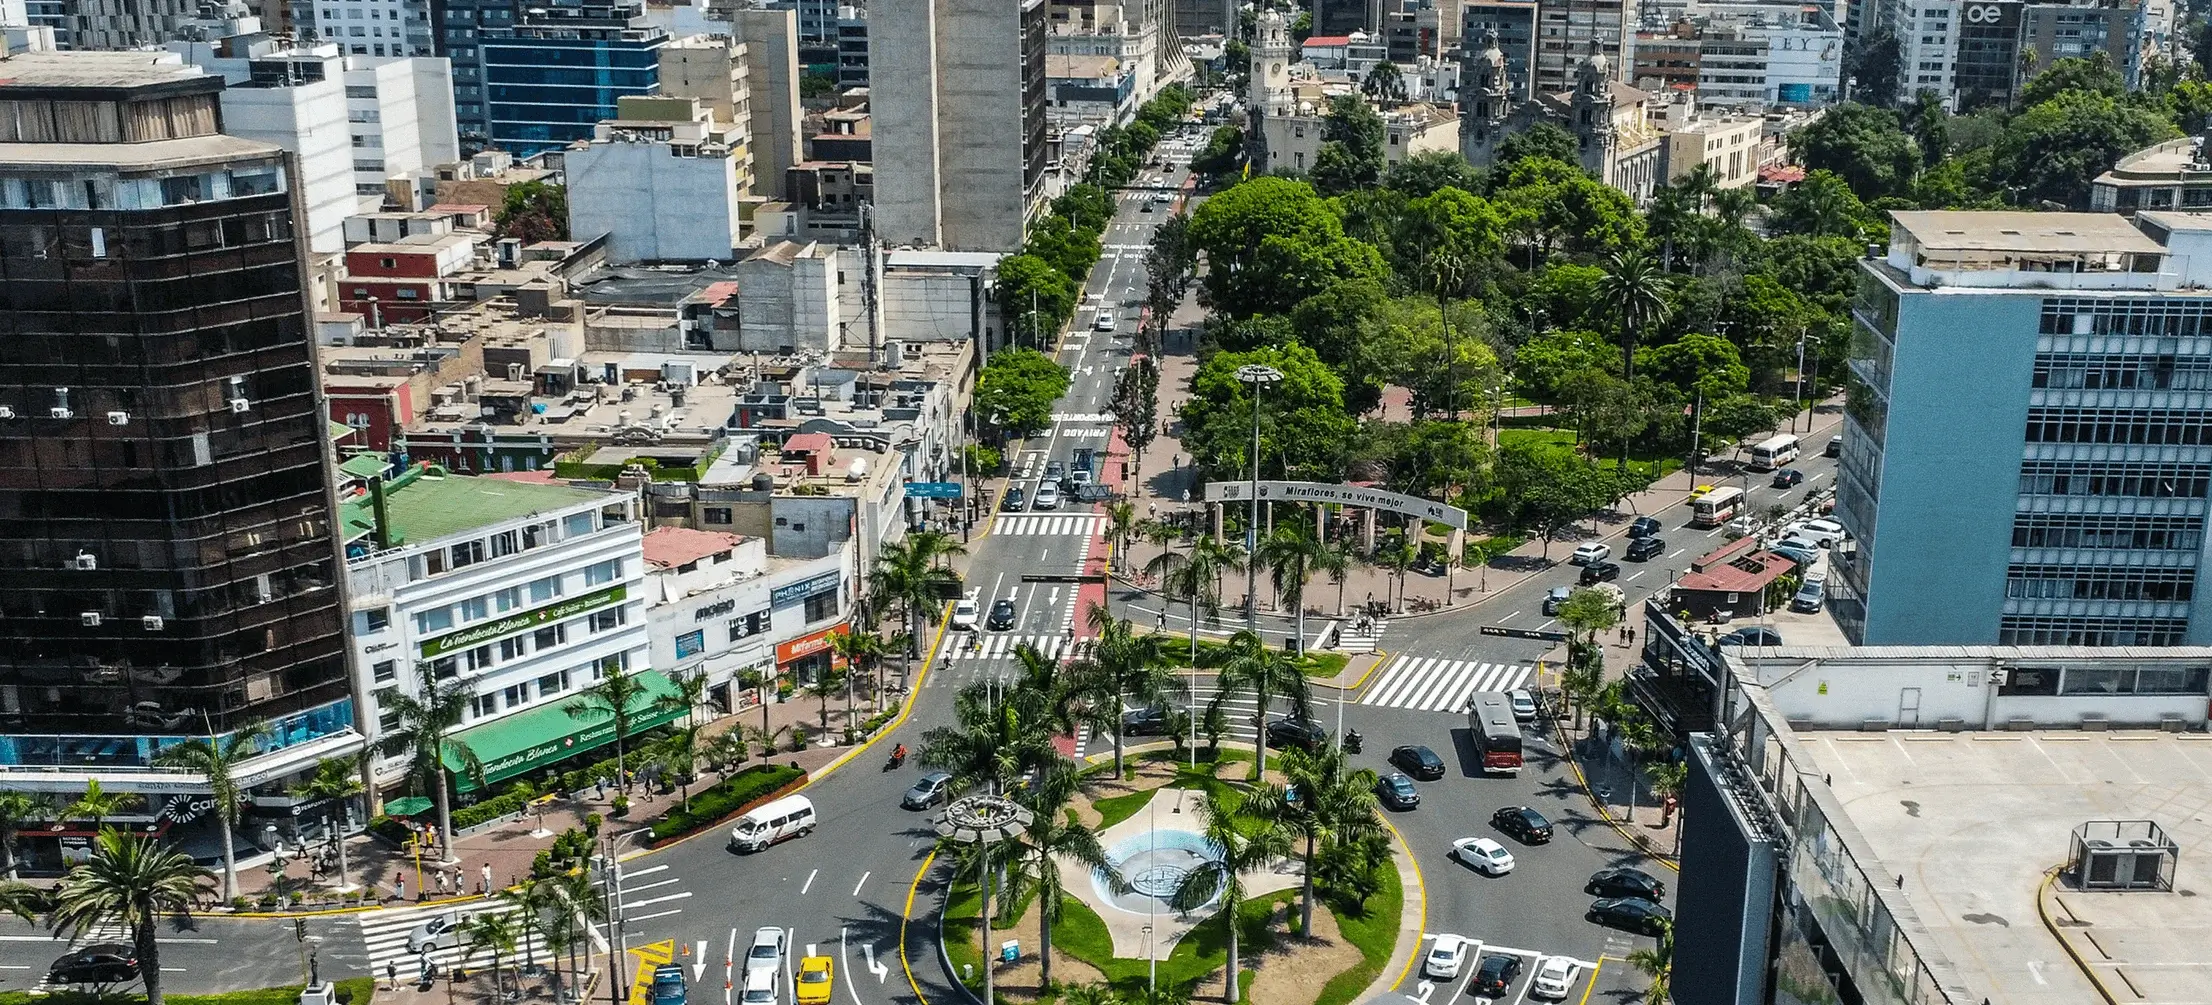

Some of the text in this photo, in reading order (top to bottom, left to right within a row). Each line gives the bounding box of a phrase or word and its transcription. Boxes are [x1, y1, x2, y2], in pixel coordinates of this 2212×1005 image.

[1967, 5, 2002, 23] oe
[1063, 428, 1107, 438] PRIVADO
[1285, 486, 1338, 499] Miraflores,
[1356, 492, 1375, 502] vive
[1377, 495, 1404, 509] mejor
[440, 636, 454, 650] La
[497, 617, 532, 634] Blanca
[526, 744, 559, 762] Blanca
